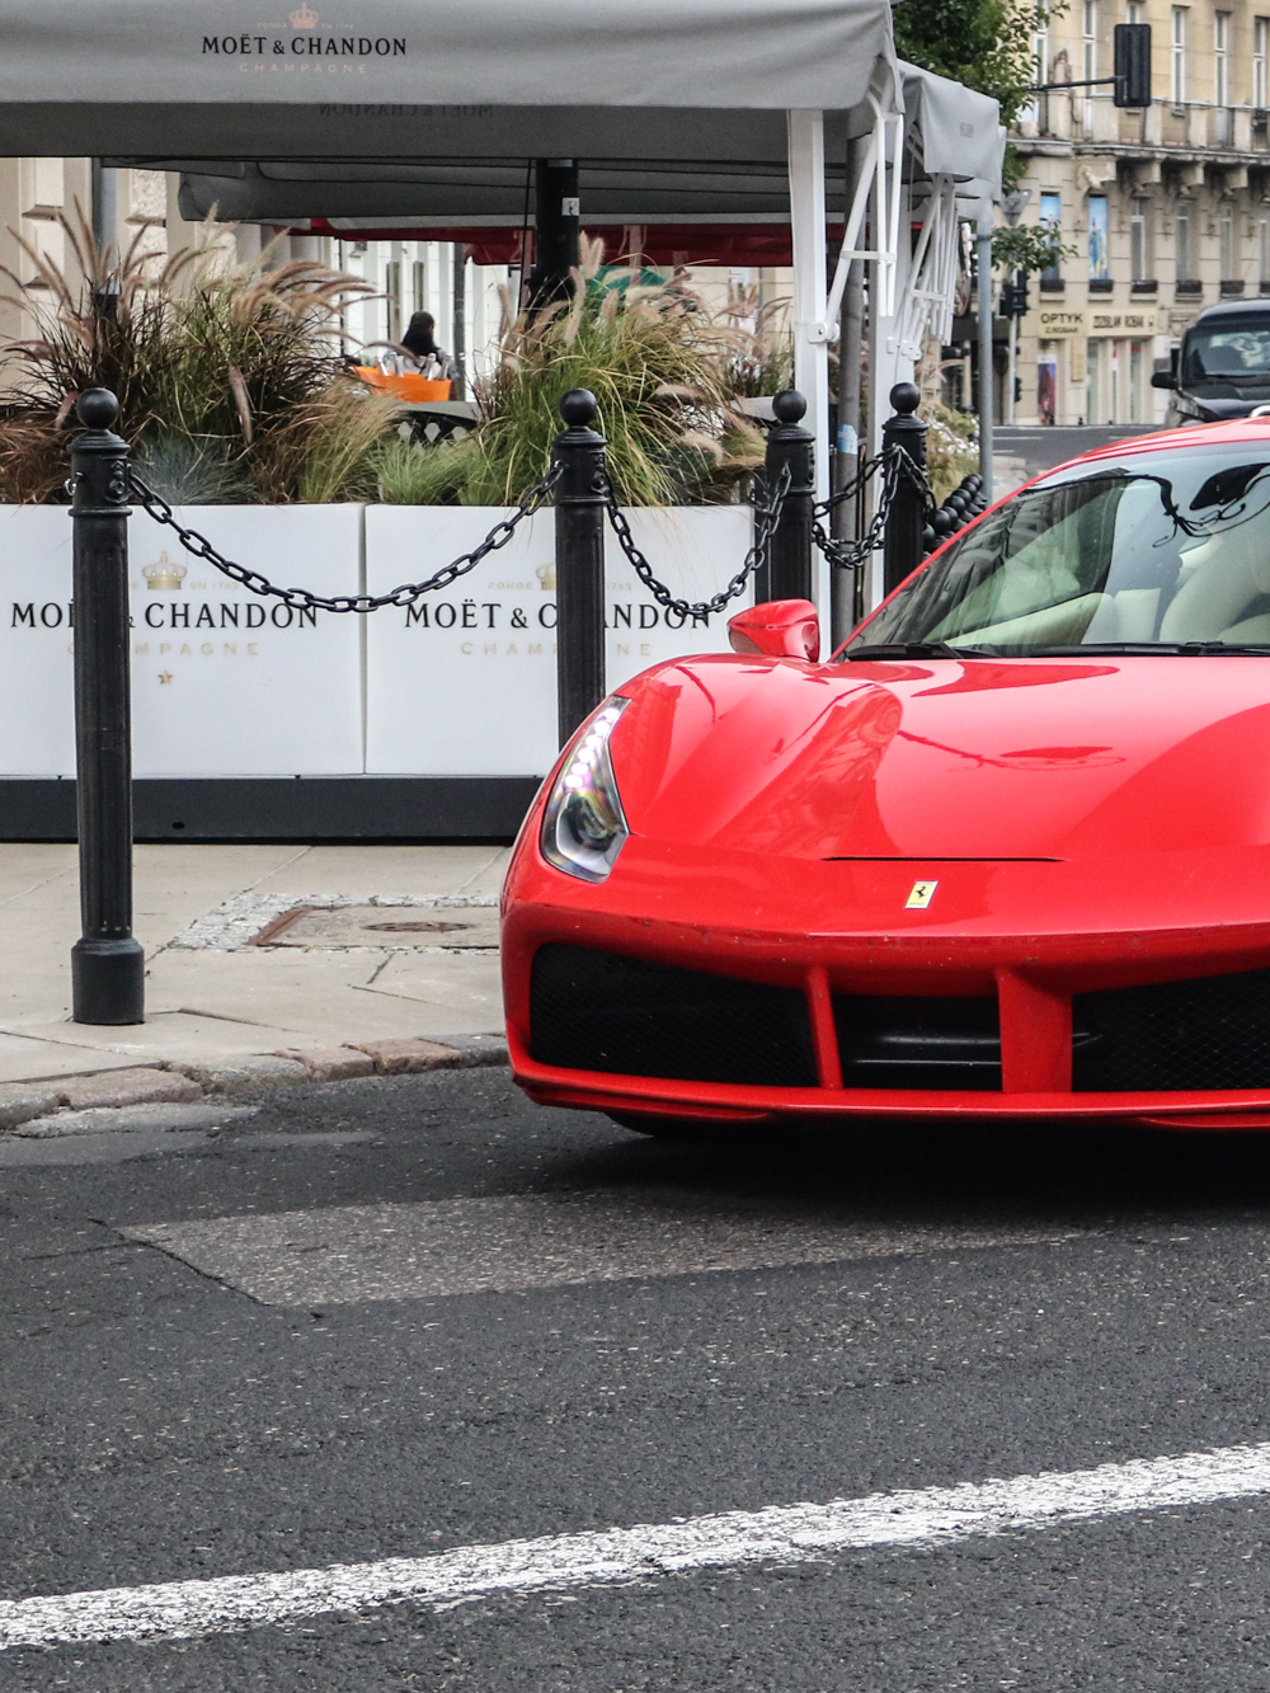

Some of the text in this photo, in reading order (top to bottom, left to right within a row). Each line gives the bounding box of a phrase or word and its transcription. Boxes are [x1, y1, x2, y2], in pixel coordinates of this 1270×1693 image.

[202, 34, 406, 56] MOËT & CHANDON
[239, 63, 367, 73] CHAMPAGNE
[1040, 313, 1083, 323] OPTYK
[11, 600, 74, 628] MO
[145, 603, 318, 628] CHANDON
[405, 599, 710, 629] MOËT & CNDON
[461, 643, 651, 656] CHAMNE
